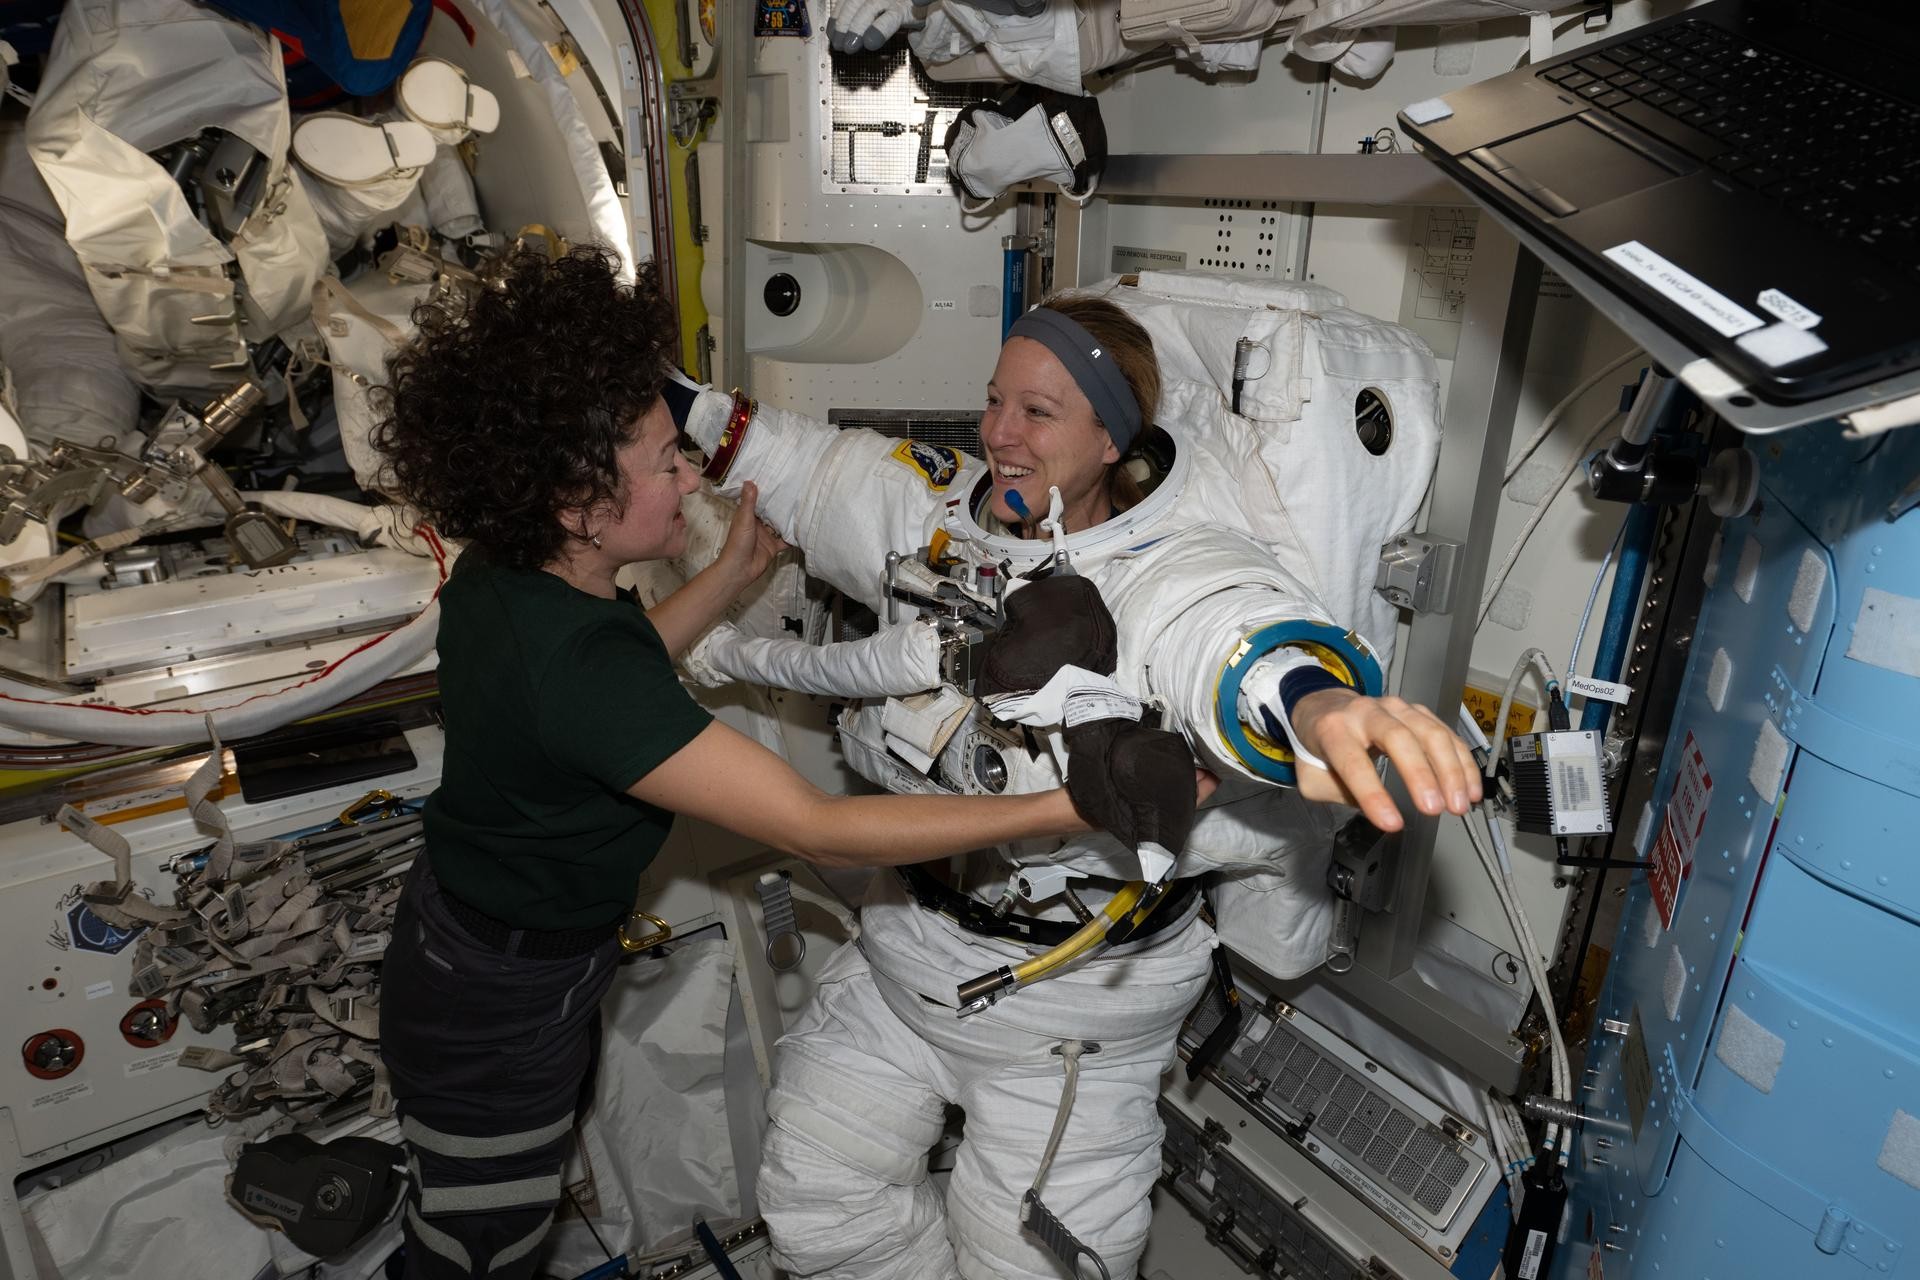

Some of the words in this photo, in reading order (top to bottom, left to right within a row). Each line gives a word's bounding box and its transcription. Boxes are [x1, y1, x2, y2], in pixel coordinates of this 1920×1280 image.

[1126, 250, 1149, 260] REMOVAL
[1150, 252, 1182, 262] RECEPTACLE
[1572, 680, 1615, 696] MedOps02
[1682, 786, 1696, 821] FIRE
[1659, 876, 1674, 919] PFE
